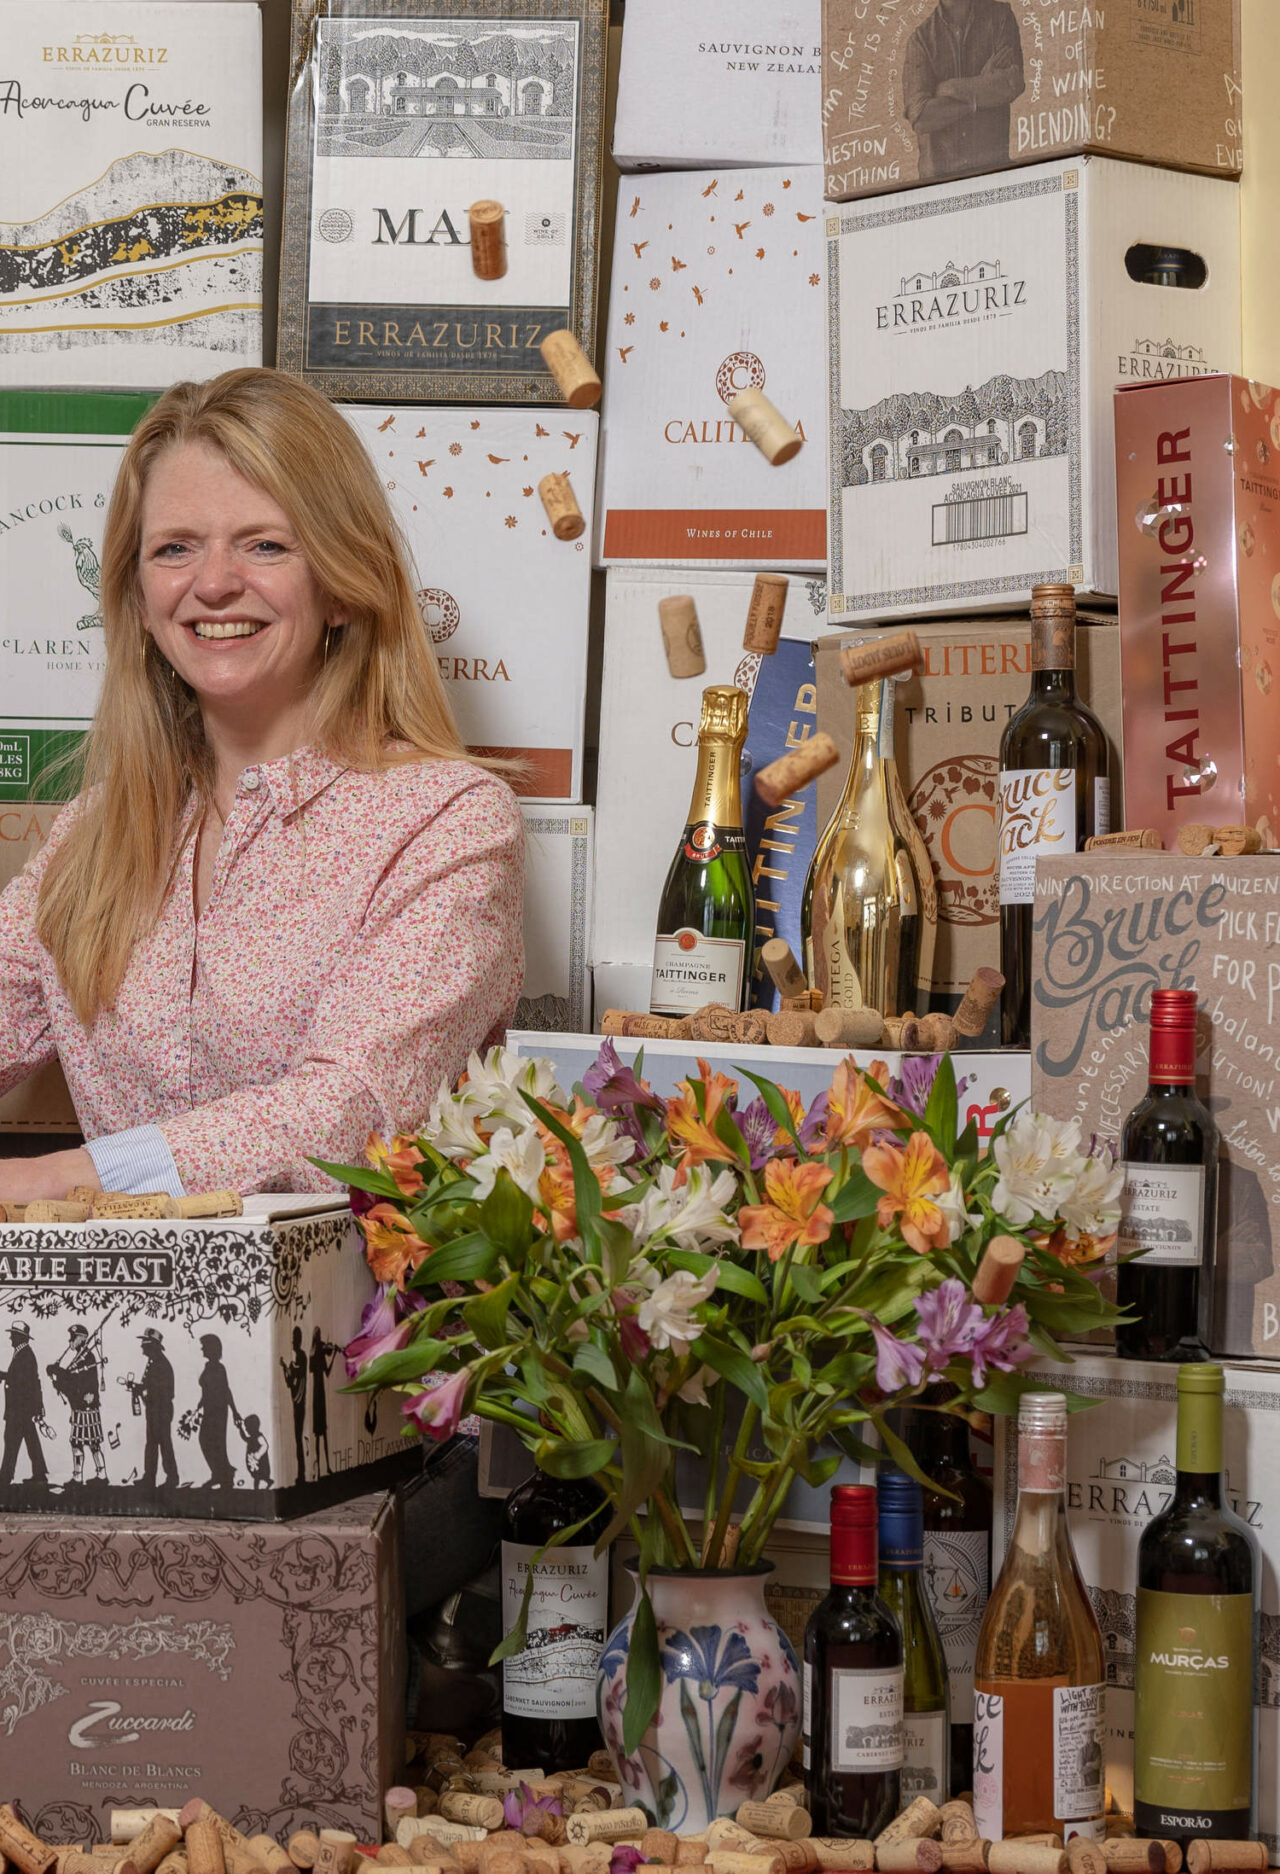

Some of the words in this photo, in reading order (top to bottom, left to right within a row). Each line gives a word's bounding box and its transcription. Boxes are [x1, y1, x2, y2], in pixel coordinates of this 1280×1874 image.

[1050, 8, 1105, 37] MEAN
[42, 47, 168, 63] ERRAZURIZ
[698, 42, 804, 57] SAUVIGNON
[1065, 40, 1083, 60] OF
[726, 61, 760, 72] NEW
[848, 62, 875, 122] TRUTH
[864, 33, 881, 53] IS
[1052, 69, 1107, 97] WINE
[124, 83, 211, 120] Cuvée
[146, 119, 170, 127] GRAN
[172, 119, 211, 128] RESERVA
[1018, 104, 1116, 152] BLENDING?
[371, 207, 510, 247] MA
[876, 281, 1028, 330] ERRAZURIZ
[333, 321, 544, 349] ERRAZURIZ
[951, 479, 989, 494] SAUVIGNON
[990, 475, 1013, 487] BLANC
[944, 489, 985, 503] ACONCAGUA
[686, 528, 721, 538] WINES
[724, 529, 739, 538] OF
[741, 528, 773, 538] CHILE
[1156, 426, 1203, 811] TAITTINGER
[47, 661, 82, 670] HOME
[905, 704, 1018, 725] TRIBUT
[704, 750, 717, 808] TAITTINGER
[1084, 874, 1173, 895] DIRECTION
[1180, 875, 1202, 893] AT
[1033, 876, 1227, 989] Bruce
[1219, 908, 1258, 942] PICK
[665, 961, 711, 969] CHAMPAGNE
[656, 969, 726, 982] TAITTINGER
[1212, 954, 1257, 1001] FOR
[1223, 1119, 1267, 1167] Listen
[78, 1258, 167, 1284] FEAST
[332, 1447, 353, 1473] THE
[517, 1562, 589, 1576] ERRAZURIZ
[560, 1583, 600, 1603] Cuvée
[1150, 1652, 1230, 1671] MURÇAS
[80, 1677, 120, 1687] CUVÉE
[125, 1678, 185, 1688] ESPECIAL
[531, 1698, 571, 1707] SAUVIGNON
[68, 1700, 197, 1748] Zuccardi
[70, 1762, 117, 1776] BLANC
[122, 1765, 141, 1776] DE
[146, 1763, 201, 1777] BLANCS
[81, 1781, 128, 1790] MENDOZA
[134, 1781, 190, 1790] ARGENTINA
[1160, 1814, 1213, 1829] ESPORÃO
